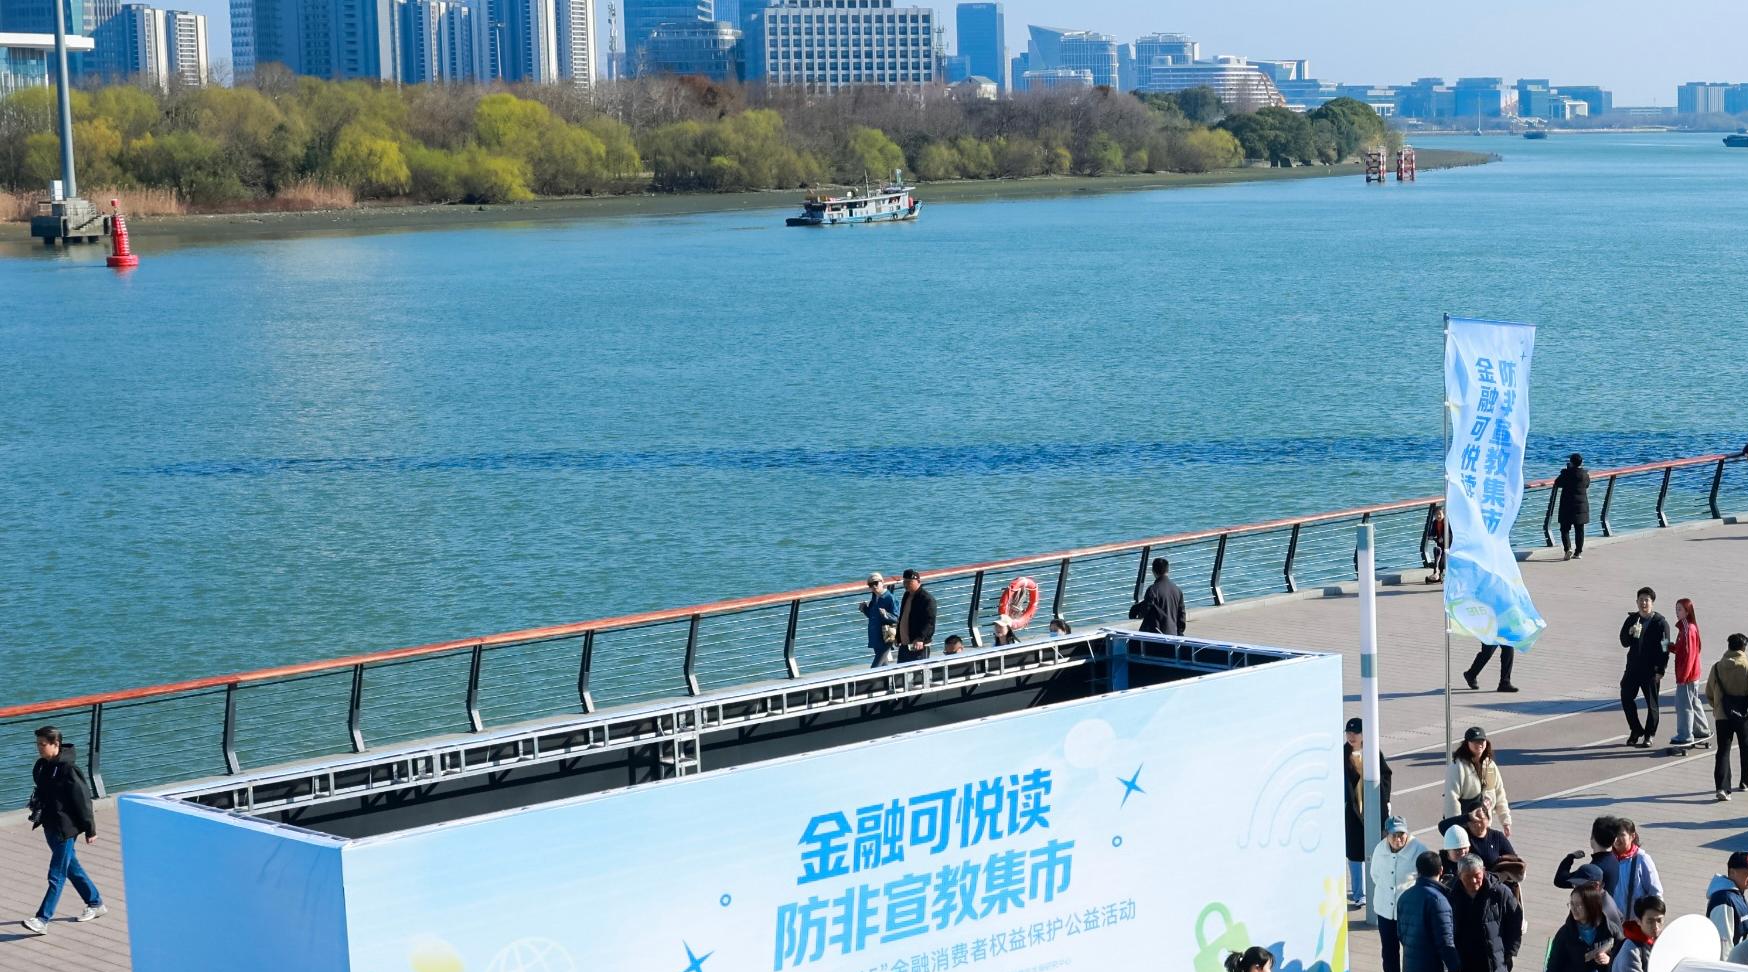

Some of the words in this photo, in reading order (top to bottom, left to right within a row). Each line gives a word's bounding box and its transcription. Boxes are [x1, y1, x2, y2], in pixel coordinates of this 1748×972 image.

[796, 768, 1053, 886] 金融可悦读
[772, 839, 1076, 972] 防非宣教集市
